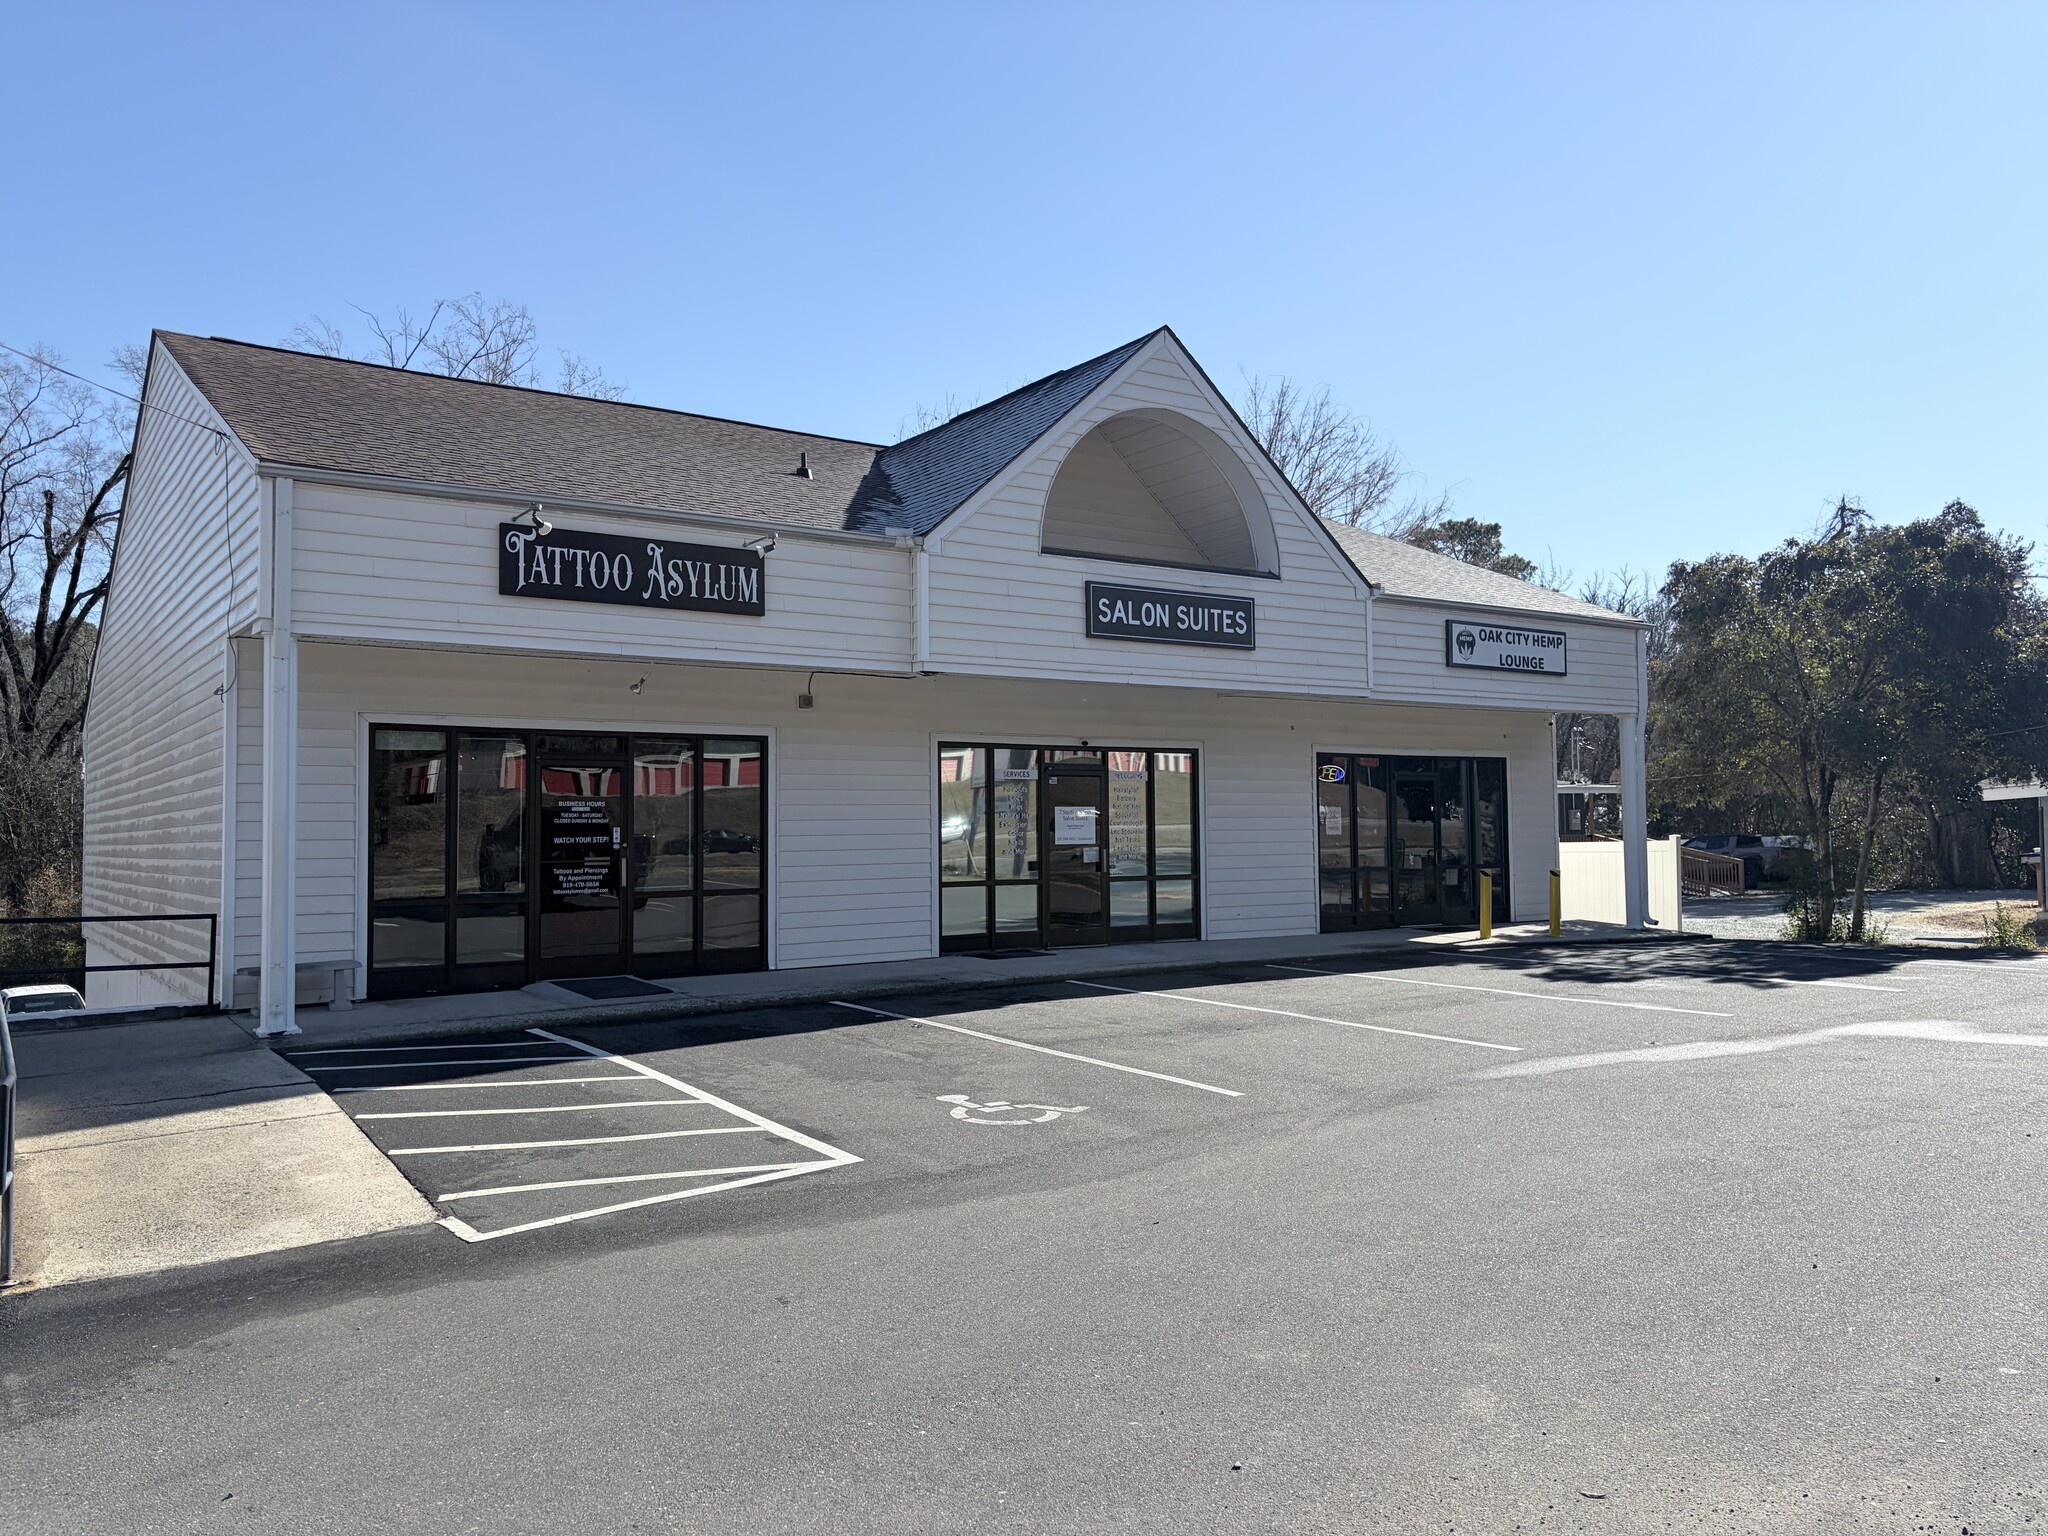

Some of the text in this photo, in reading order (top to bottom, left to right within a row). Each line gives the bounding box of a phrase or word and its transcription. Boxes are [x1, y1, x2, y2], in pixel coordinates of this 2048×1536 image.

[1098, 598, 1248, 634] SALON SUITES
[1478, 628, 1562, 649] OAK CITY HEMP
[1500, 654, 1544, 669] LOUNGE
